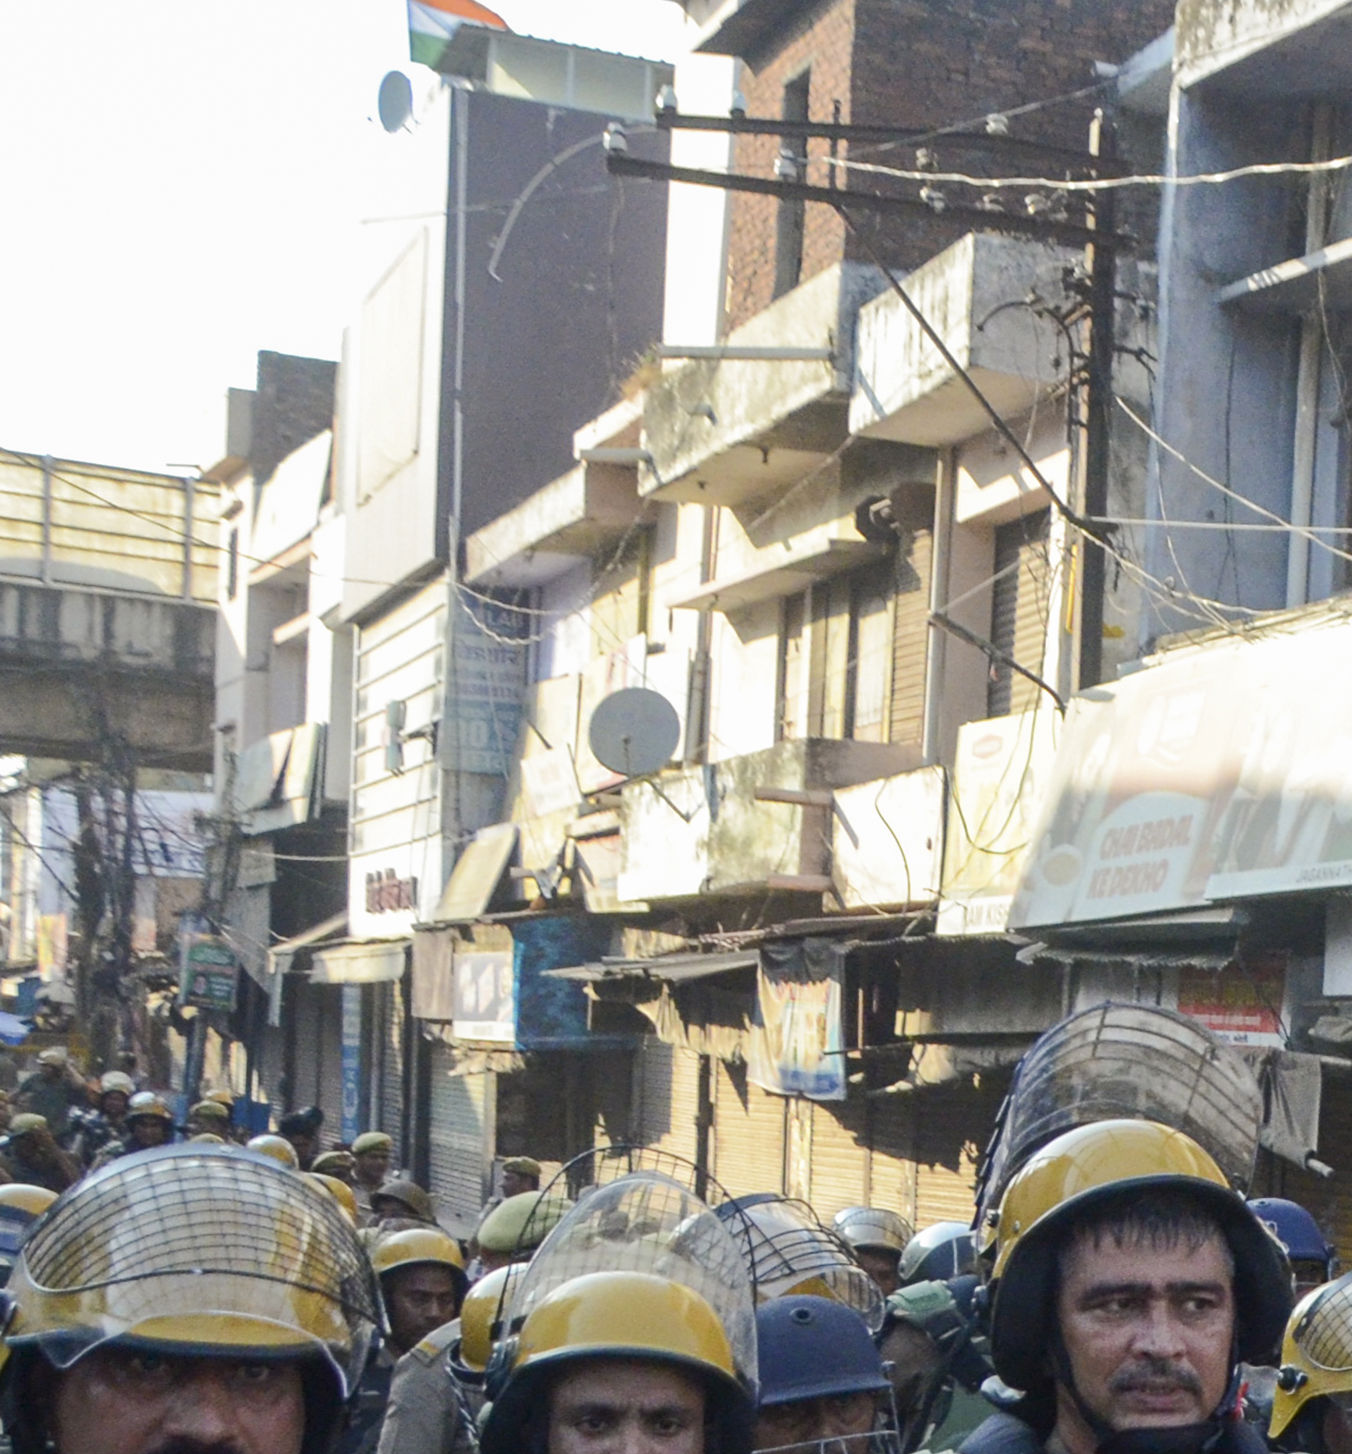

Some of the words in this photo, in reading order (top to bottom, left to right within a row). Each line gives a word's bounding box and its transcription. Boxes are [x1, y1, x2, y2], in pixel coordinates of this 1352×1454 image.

[1099, 823, 1141, 861] CHAI
[1136, 813, 1194, 854] BADAL
[1085, 866, 1113, 899] KE
[1111, 858, 1169, 897] DEKHO
